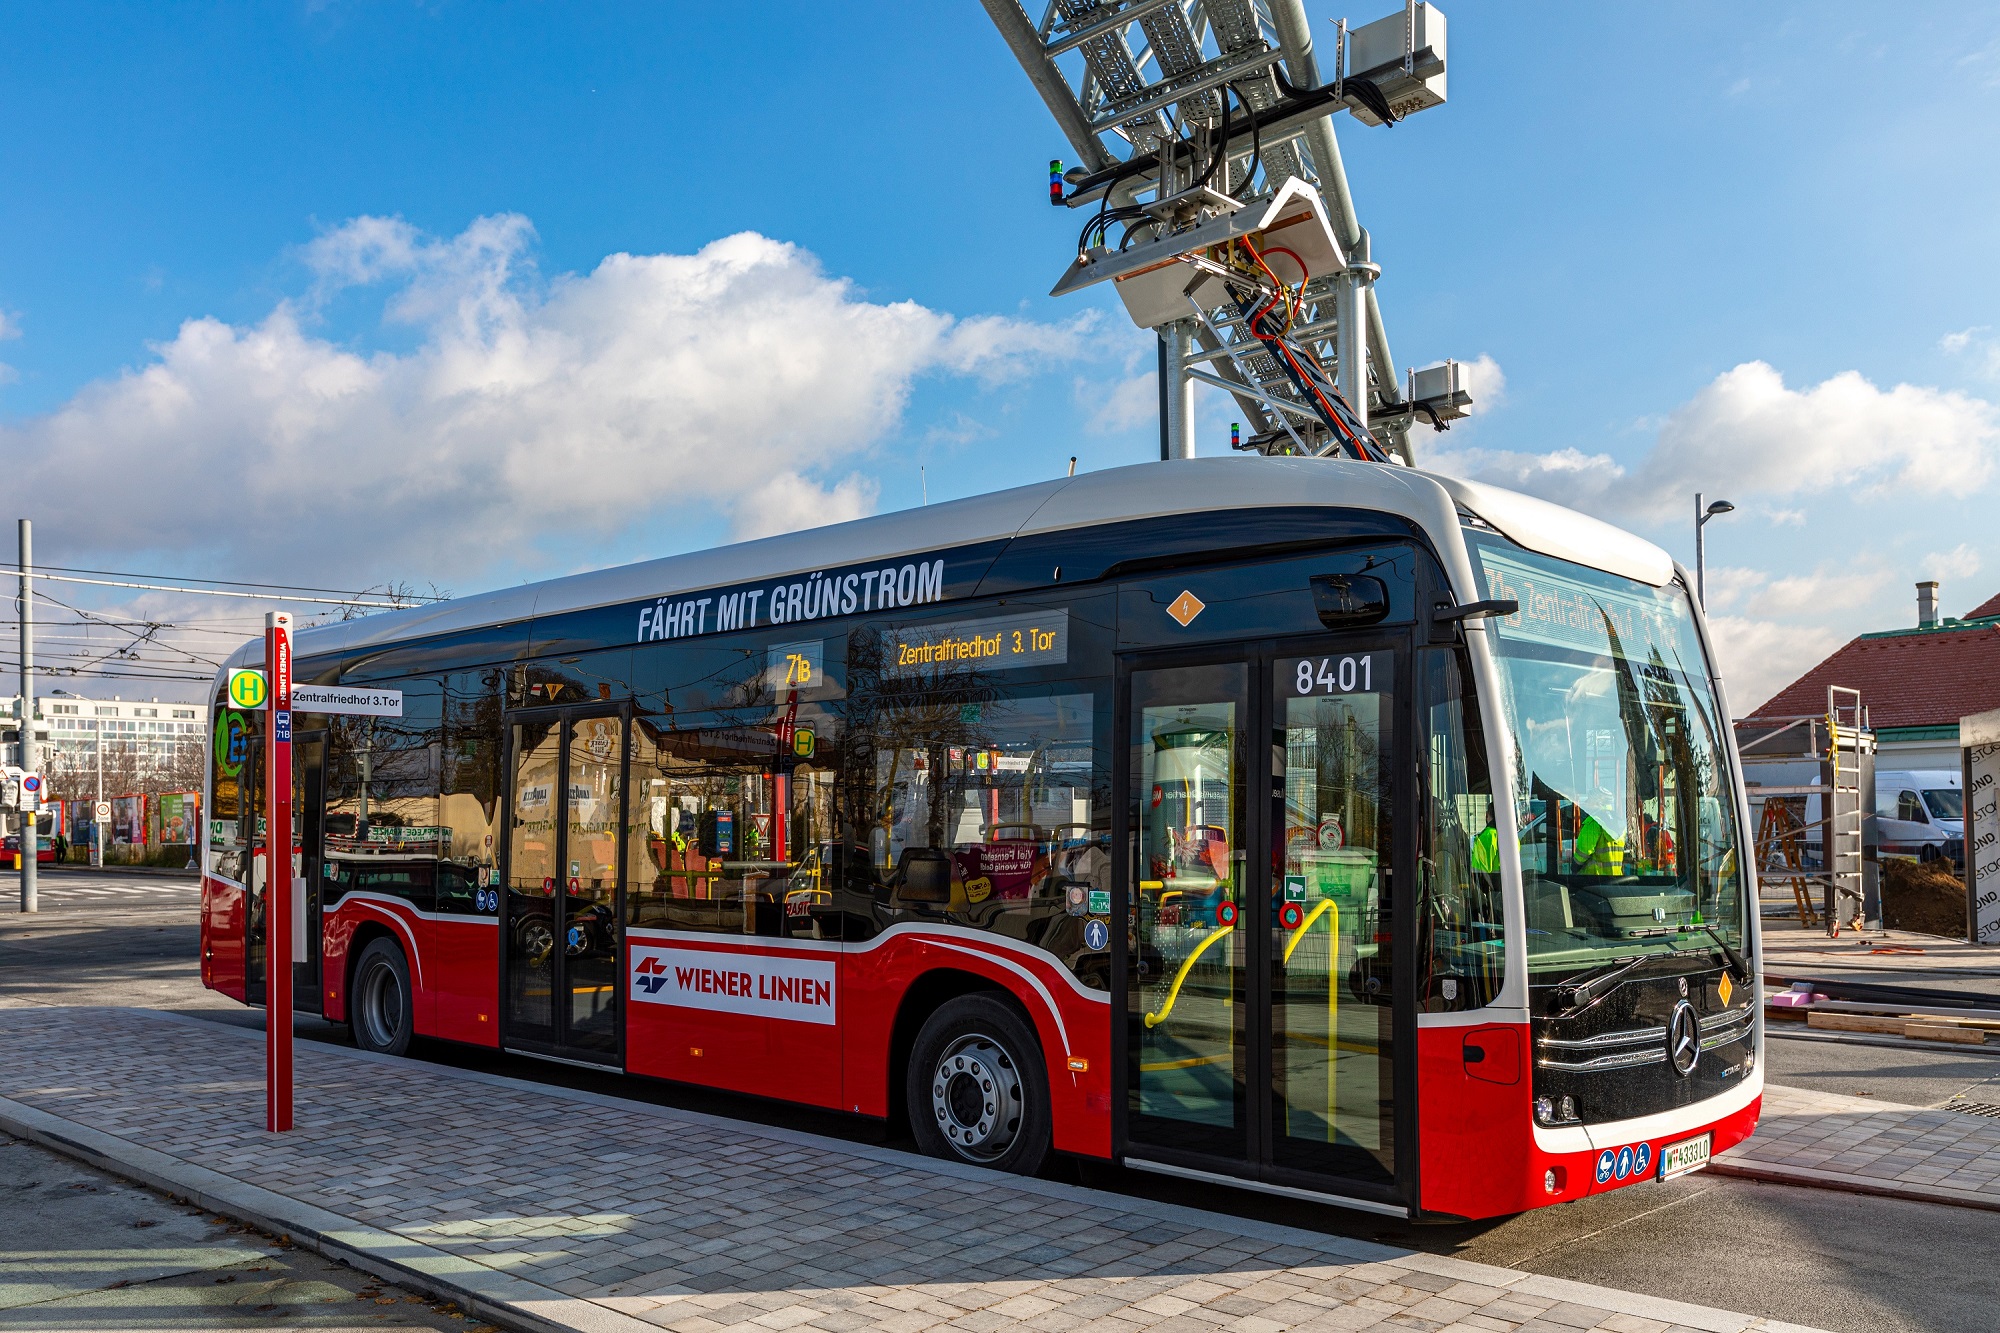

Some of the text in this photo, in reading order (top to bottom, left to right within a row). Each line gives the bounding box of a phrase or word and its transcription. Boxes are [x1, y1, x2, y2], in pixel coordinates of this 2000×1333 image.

[638, 560, 944, 642] FÄHRT MIT GRÜNSTROM
[899, 628, 1056, 665] Zentralfriedhof 3. Tor
[785, 653, 811, 684] 71B
[1296, 655, 1371, 694] 8401
[240, 677, 258, 701] H
[292, 691, 371, 706] Zentralfriedhof
[276, 730, 290, 739] 71B
[675, 966, 831, 1008] WIENER LINIEN
